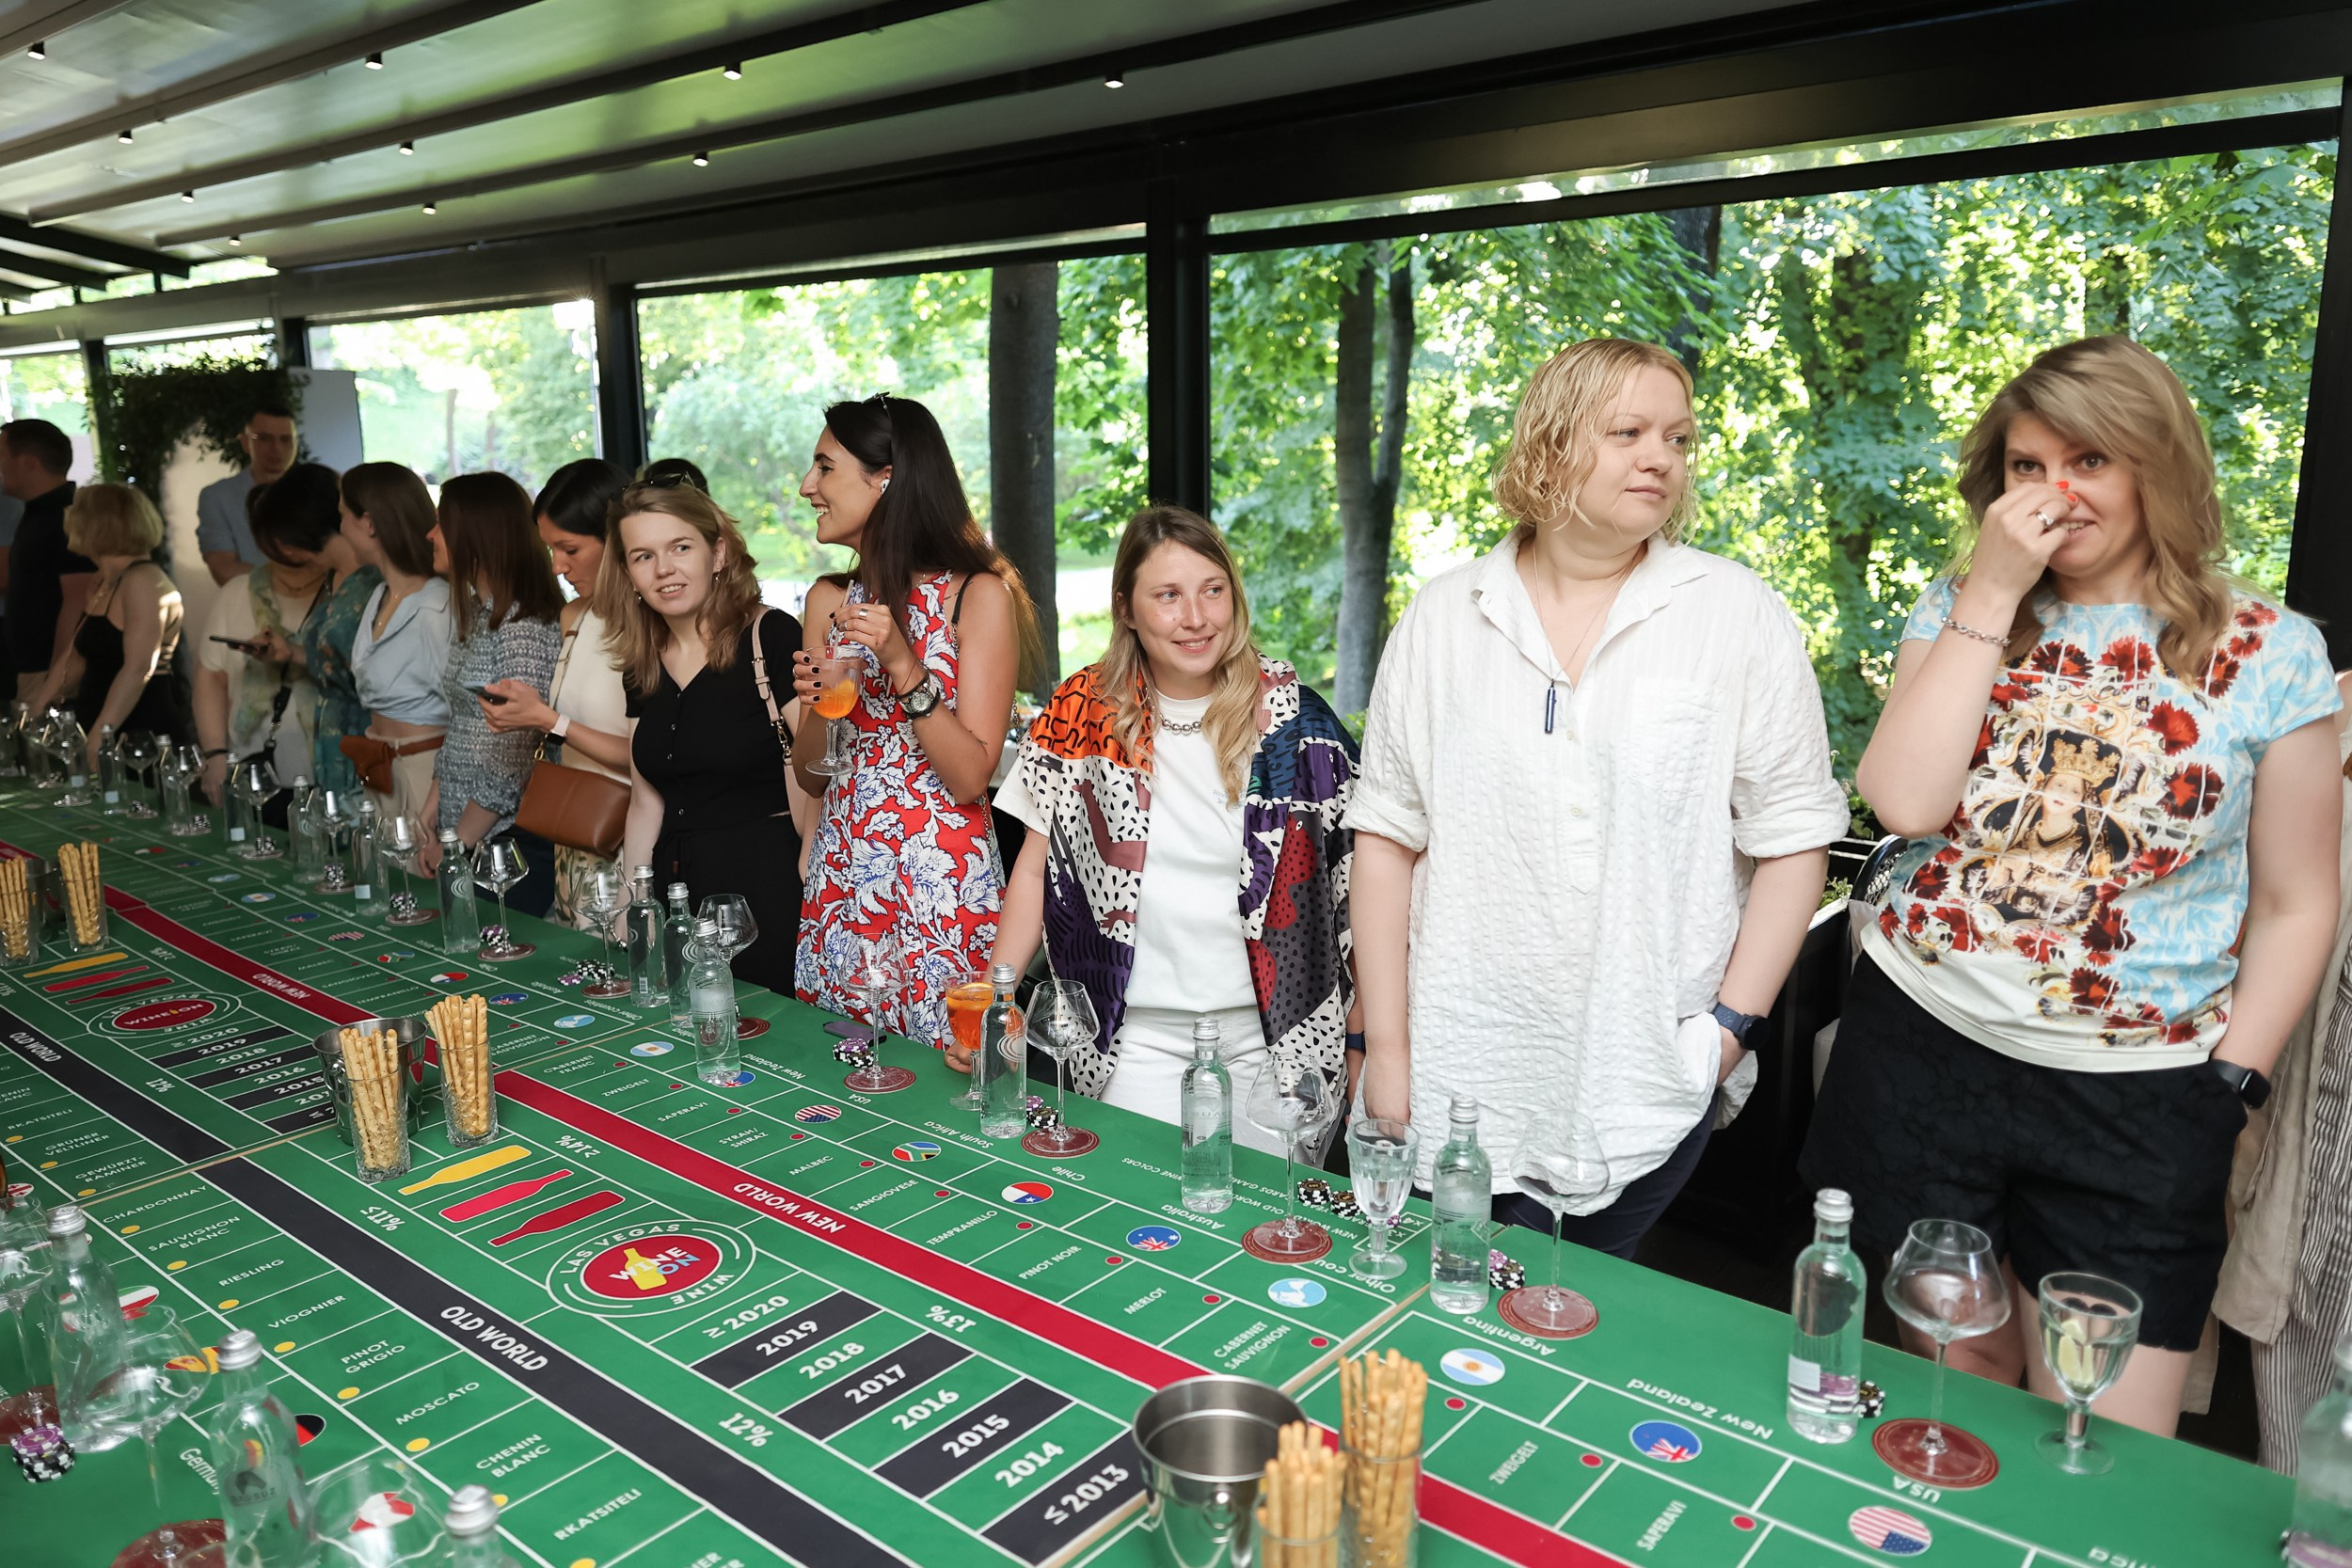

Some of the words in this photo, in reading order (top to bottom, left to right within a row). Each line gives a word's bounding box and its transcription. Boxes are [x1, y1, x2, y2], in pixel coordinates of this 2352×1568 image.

[102, 1006, 132, 1019] LAS
[135, 993, 200, 1006] VEGAS
[124, 1010, 171, 1026] WINE
[164, 1018, 215, 1033] WINE
[187, 1026, 240, 1045] 2020
[8, 1031, 36, 1046] OLD
[24, 1039, 62, 1063] WORLD
[198, 1037, 248, 1055] 2019
[215, 1047, 268, 1065] 2018
[234, 1056, 284, 1075] 2017
[542, 1054, 595, 1074] CABERNET
[559, 1060, 596, 1075] FRANC
[741, 1053, 780, 1071] Zealand
[783, 1067, 807, 1081] New
[145, 1078, 176, 1093] 12%
[253, 1066, 308, 1085] 2016
[274, 1075, 325, 1095] 2015
[602, 1078, 651, 1098] ZWEIGELT
[294, 1089, 330, 1106] 201
[848, 1092, 873, 1106] USA
[7, 1108, 73, 1130] RKATSITELI
[657, 1101, 709, 1123] SAPERAVI
[45, 1132, 101, 1151] GRÜNER
[718, 1126, 758, 1146] SYRAH/
[730, 1132, 769, 1149] SHIRAZ
[923, 1120, 962, 1138] Africa
[960, 1132, 994, 1149] South
[44, 1134, 110, 1156] VELTLINER
[75, 1156, 144, 1180] GEWÜRZT-
[85, 1160, 148, 1183] RAMINER
[788, 1155, 834, 1176] MALBEC
[1051, 1165, 1086, 1182] Chile
[1120, 1157, 1161, 1174] COLORS
[102, 1185, 208, 1224] CHARDONNAY
[733, 1182, 802, 1215] WORLD
[849, 1179, 919, 1212] SANGIOVESE
[795, 1210, 848, 1234] NEW
[1160, 1204, 1226, 1230] Australia
[1263, 1203, 1286, 1216] OLD
[148, 1215, 241, 1253] SAUVIGNON
[179, 1227, 231, 1250] BLANC
[926, 1210, 999, 1247] TEMPRANILLO
[1330, 1227, 1359, 1241] NEW
[560, 1248, 595, 1275] LAS
[593, 1224, 681, 1248] VEGAS
[1018, 1259, 1056, 1280] PINOT
[1051, 1245, 1083, 1263] NOIR
[218, 1258, 286, 1287] RIESLING
[608, 1245, 689, 1282] WINE
[655, 1253, 702, 1275] ON
[669, 1273, 736, 1306] WINE
[1347, 1269, 1397, 1294] Other
[267, 1294, 347, 1329] VIOGNIER
[722, 1294, 790, 1333] 2020
[1124, 1287, 1168, 1316] MERLOT
[925, 1304, 978, 1334] 13%
[440, 1305, 486, 1332] OLD
[475, 1324, 549, 1370] WORLD
[755, 1318, 821, 1358] 2019
[1213, 1320, 1270, 1359] CABERNET
[1223, 1323, 1293, 1370] SAUVIGNON
[1462, 1315, 1558, 1356] Argentina
[341, 1339, 390, 1365] PINOT
[344, 1344, 406, 1374] GRIGIO
[798, 1339, 867, 1381] 2018
[844, 1362, 909, 1405] 2017
[395, 1381, 481, 1426] MOSCATO
[890, 1387, 961, 1432] 2016
[1626, 1377, 1719, 1419] Zealand
[717, 1412, 777, 1449] 12%
[941, 1413, 1012, 1459] 2015
[1720, 1411, 1774, 1440] New
[475, 1433, 544, 1470] CHENIN
[491, 1444, 552, 1479] BLANC
[993, 1439, 1067, 1488] 2014
[1488, 1439, 1539, 1486] ZWEIGELT
[1058, 1462, 1131, 1517] 2013
[1892, 1474, 1944, 1504] USA
[552, 1486, 644, 1541] RKATSITELI
[1635, 1498, 1689, 1552] SAPERAVI
